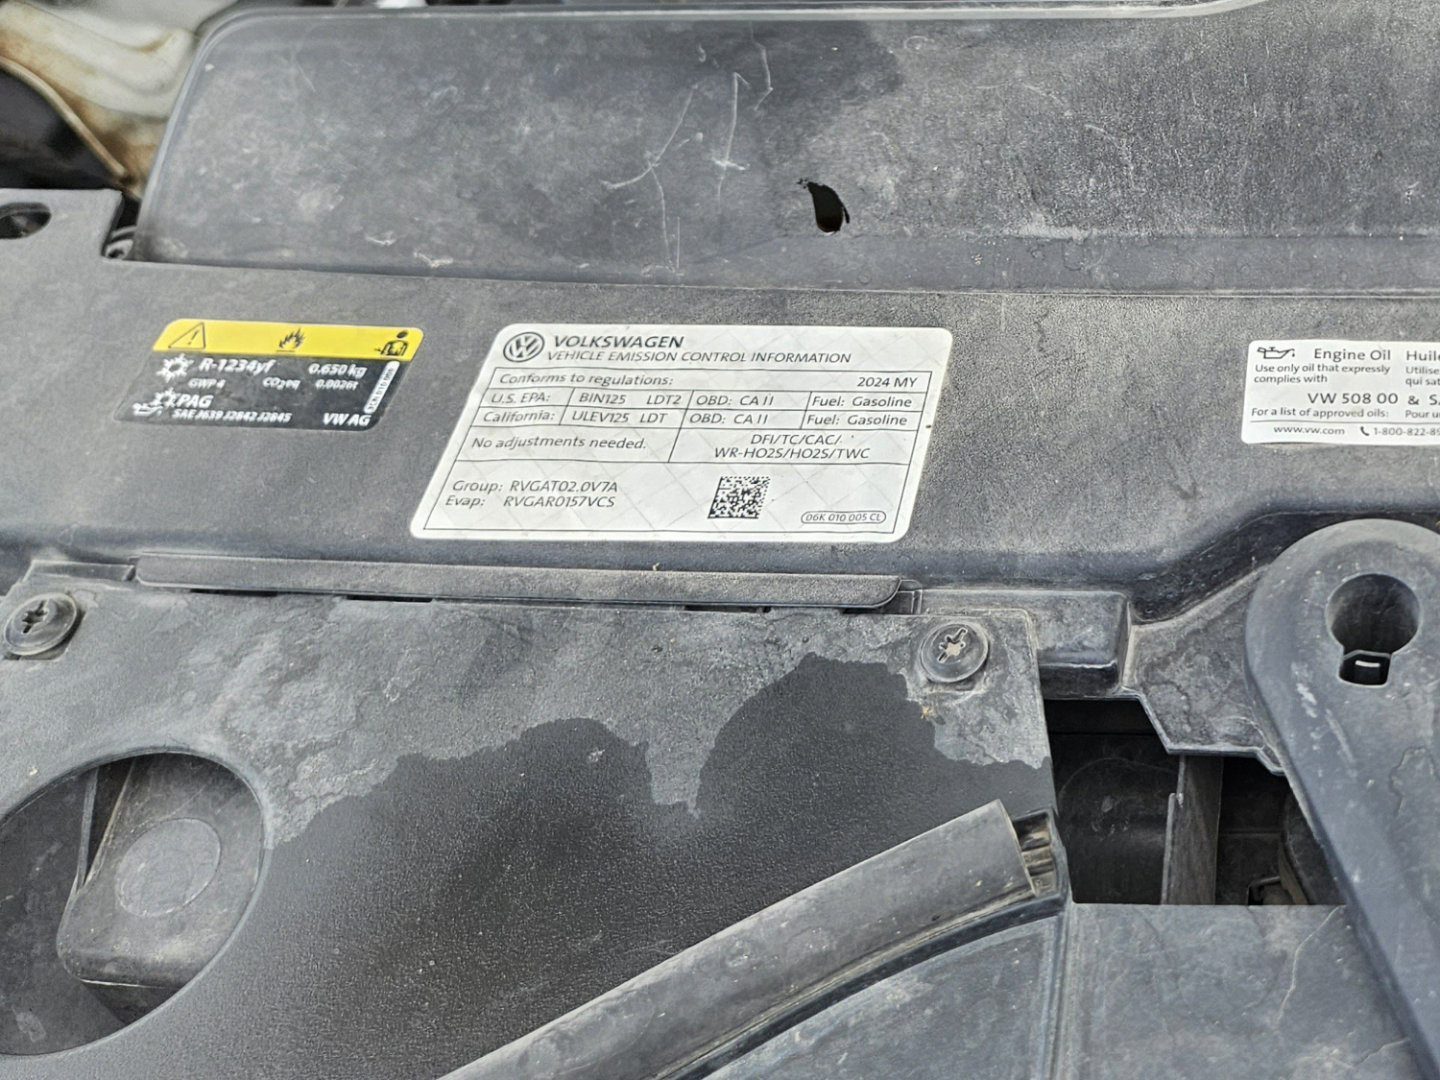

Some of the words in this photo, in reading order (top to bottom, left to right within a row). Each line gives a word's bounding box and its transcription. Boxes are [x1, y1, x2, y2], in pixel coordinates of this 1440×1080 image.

[553, 335, 684, 348] VOLKSWAGEN
[547, 351, 602, 361] VEHICLE
[608, 351, 678, 362] EMISSION
[681, 351, 746, 362] CONTROL
[751, 352, 851, 363] INFORMATION
[1314, 348, 1366, 363] Engine
[1370, 349, 1391, 361] Oil
[199, 358, 277, 376] R-1234yf
[308, 363, 348, 375] 0.650
[348, 364, 367, 379] kg
[1255, 364, 1275, 372] Use
[1277, 364, 1300, 374] only
[1302, 363, 1314, 372] oil
[1317, 364, 1339, 373] that
[1341, 365, 1391, 375] expressly
[188, 378, 217, 389] GWP
[499, 374, 566, 384] Conforms
[570, 374, 585, 384] to
[588, 374, 674, 386] regulations:
[857, 377, 890, 387] 2024
[894, 377, 918, 387] MY
[1253, 374, 1301, 386] complies
[1303, 374, 1328, 383] with
[1405, 377, 1423, 388] qui
[176, 393, 214, 408] PAG
[491, 394, 516, 403] U.S.
[521, 393, 551, 403] EPA:
[579, 392, 627, 405] BIN125
[646, 395, 682, 405] LDT2
[696, 395, 732, 406] OBD:
[739, 396, 760, 406] CA
[812, 396, 845, 407] Fuel:
[852, 396, 912, 408] Gasoline
[1307, 392, 1337, 404] VW
[1341, 392, 1371, 404] 508
[1377, 392, 1399, 405] 00
[1407, 395, 1420, 405] &
[172, 409, 197, 420] SAE
[257, 411, 292, 423] J2845
[483, 410, 555, 422] California:
[571, 411, 629, 423] ULEV125
[639, 413, 668, 423] LDT
[689, 413, 726, 424] OBD:
[733, 414, 754, 424] CA
[806, 414, 839, 425] Fuel:
[847, 414, 908, 426] Gasoline
[1251, 408, 1269, 417] For
[1280, 407, 1296, 416] list
[1299, 407, 1312, 417] of
[1312, 409, 1364, 419] approved
[1367, 409, 1390, 418] oils:
[1405, 409, 1430, 419] Pour
[323, 413, 349, 426] VW
[347, 414, 372, 426] AG
[1273, 426, 1346, 435] www.vw.com
[472, 437, 492, 448] No
[495, 437, 585, 450] adjustments
[589, 438, 647, 449] needed.
[750, 434, 843, 445] DFI/TC/CAC/
[714, 447, 870, 459] WR-HO2S/HO2S/TWC
[452, 480, 503, 493] Group:
[445, 495, 485, 509] Evap:
[828, 514, 847, 522] 010
[849, 513, 867, 522] 005
